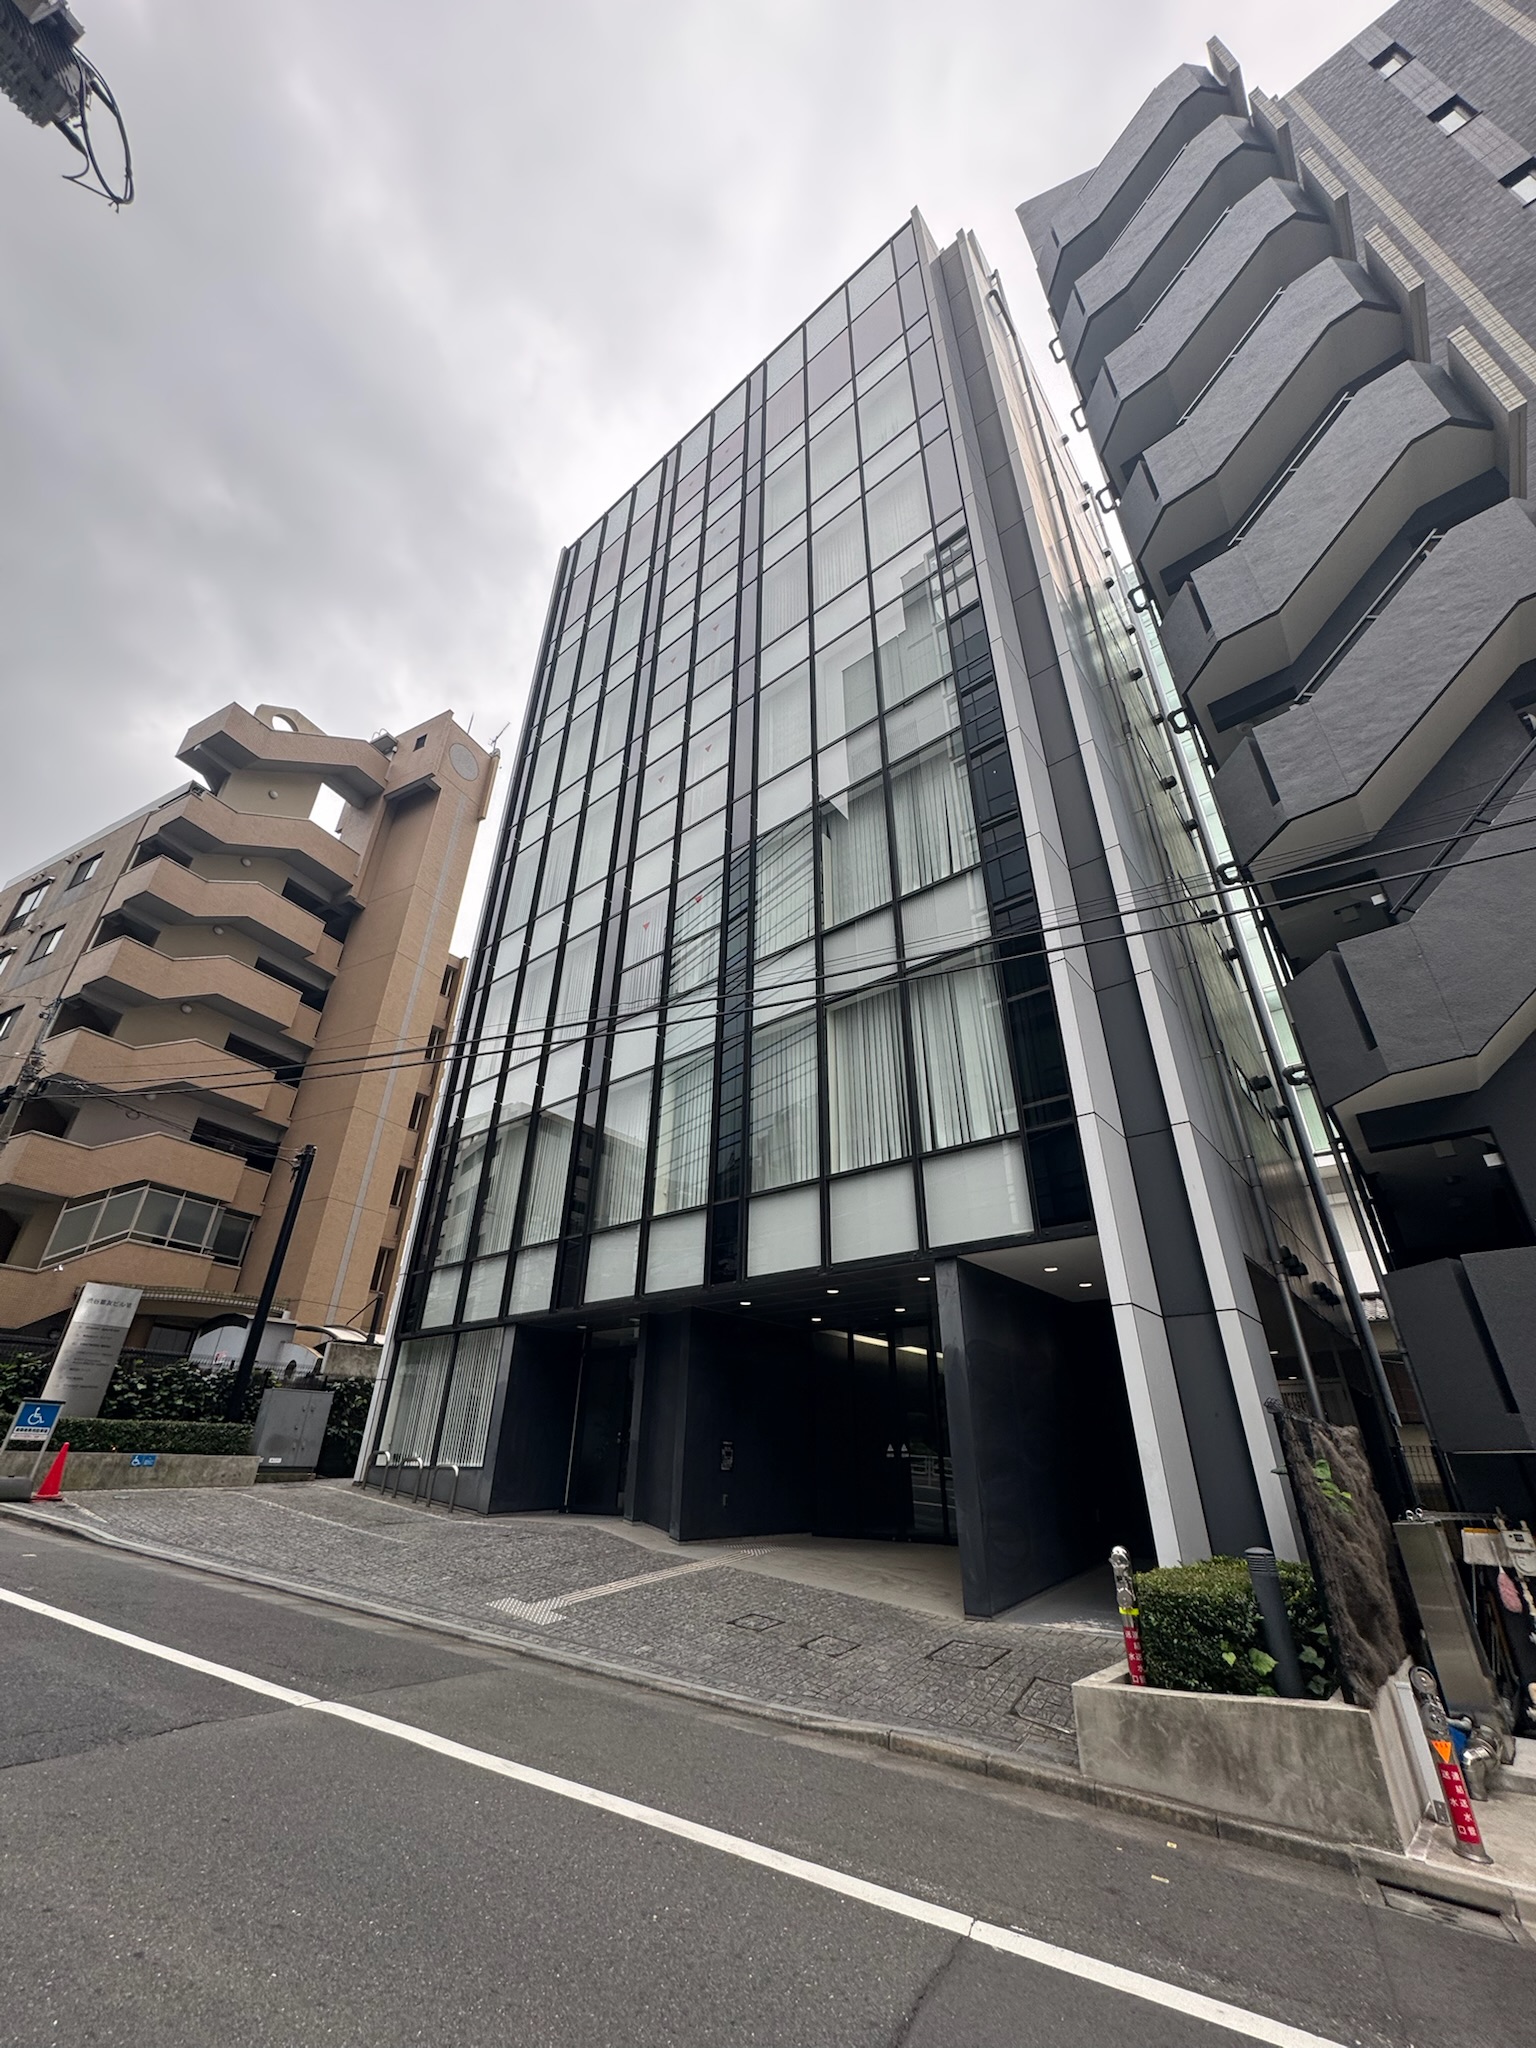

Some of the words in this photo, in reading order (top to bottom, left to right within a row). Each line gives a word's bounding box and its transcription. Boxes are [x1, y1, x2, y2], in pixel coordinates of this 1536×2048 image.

[1441, 1770, 1467, 1835] 送水口
[1451, 1771, 1477, 1836] 連結送水管
